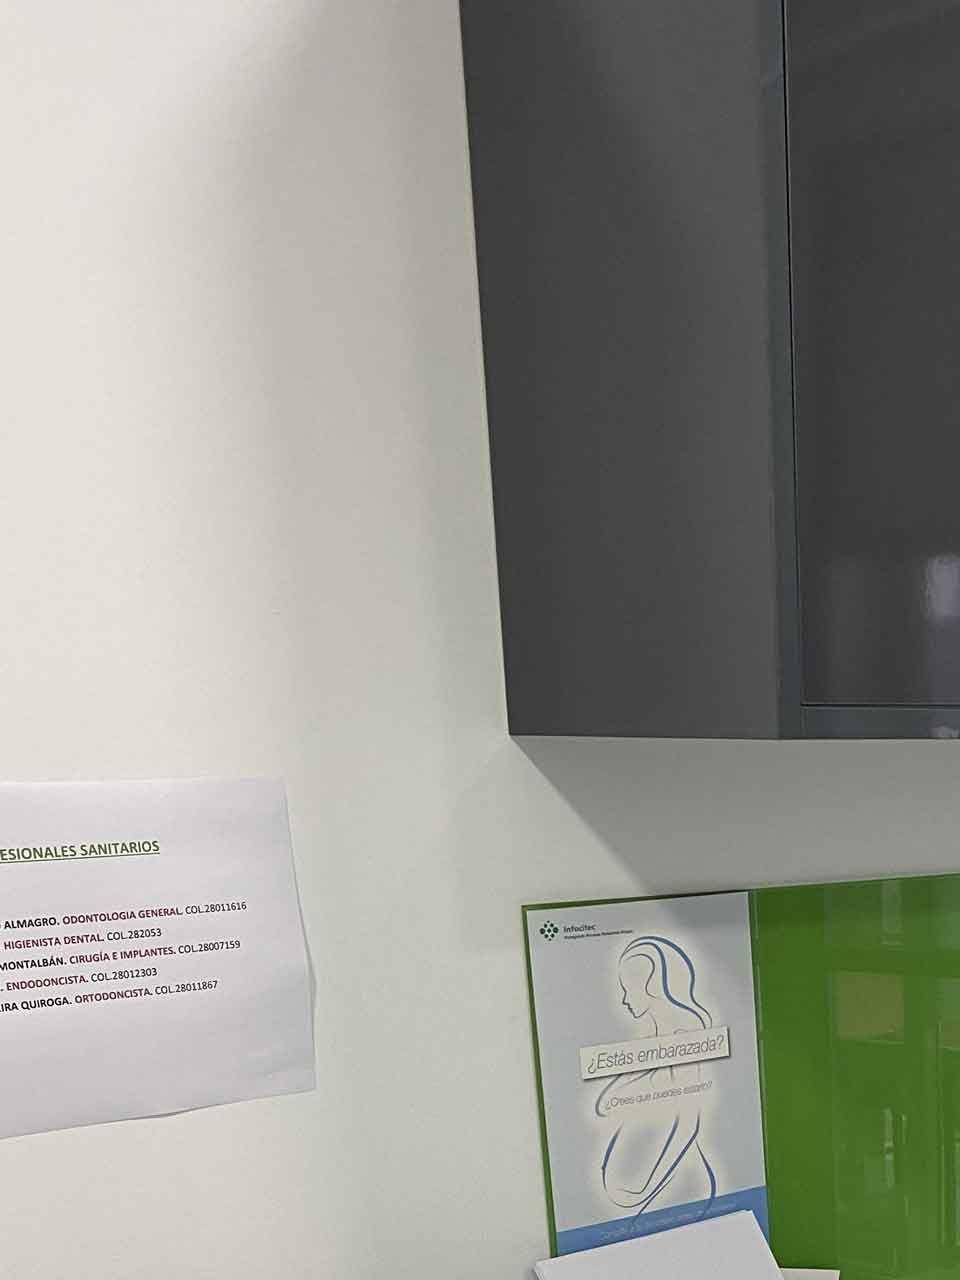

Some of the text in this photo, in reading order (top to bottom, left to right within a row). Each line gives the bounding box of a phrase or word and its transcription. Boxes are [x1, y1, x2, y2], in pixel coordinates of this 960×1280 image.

[81, 840, 160, 857] SANITARIOS
[4, 916, 60, 930] ALMAGRO.
[63, 911, 136, 926] ODONTOLOGIA
[185, 901, 247, 915] COL.28011616
[4, 936, 61, 950] HIGIENISTA
[107, 928, 162, 941] COL.282053
[70, 952, 110, 965] CIRUGÍA
[112, 951, 118, 960] E
[120, 946, 176, 960] IMPLANTES.
[6, 974, 88, 991] ENDODONCISTA.
[0, 1001, 18, 1013] IRA
[21, 996, 72, 1011] QUIROGA.
[75, 988, 153, 1005] ORTODONCISTA.
[587, 1034, 725, 1074] ¿Estás embarazada?
